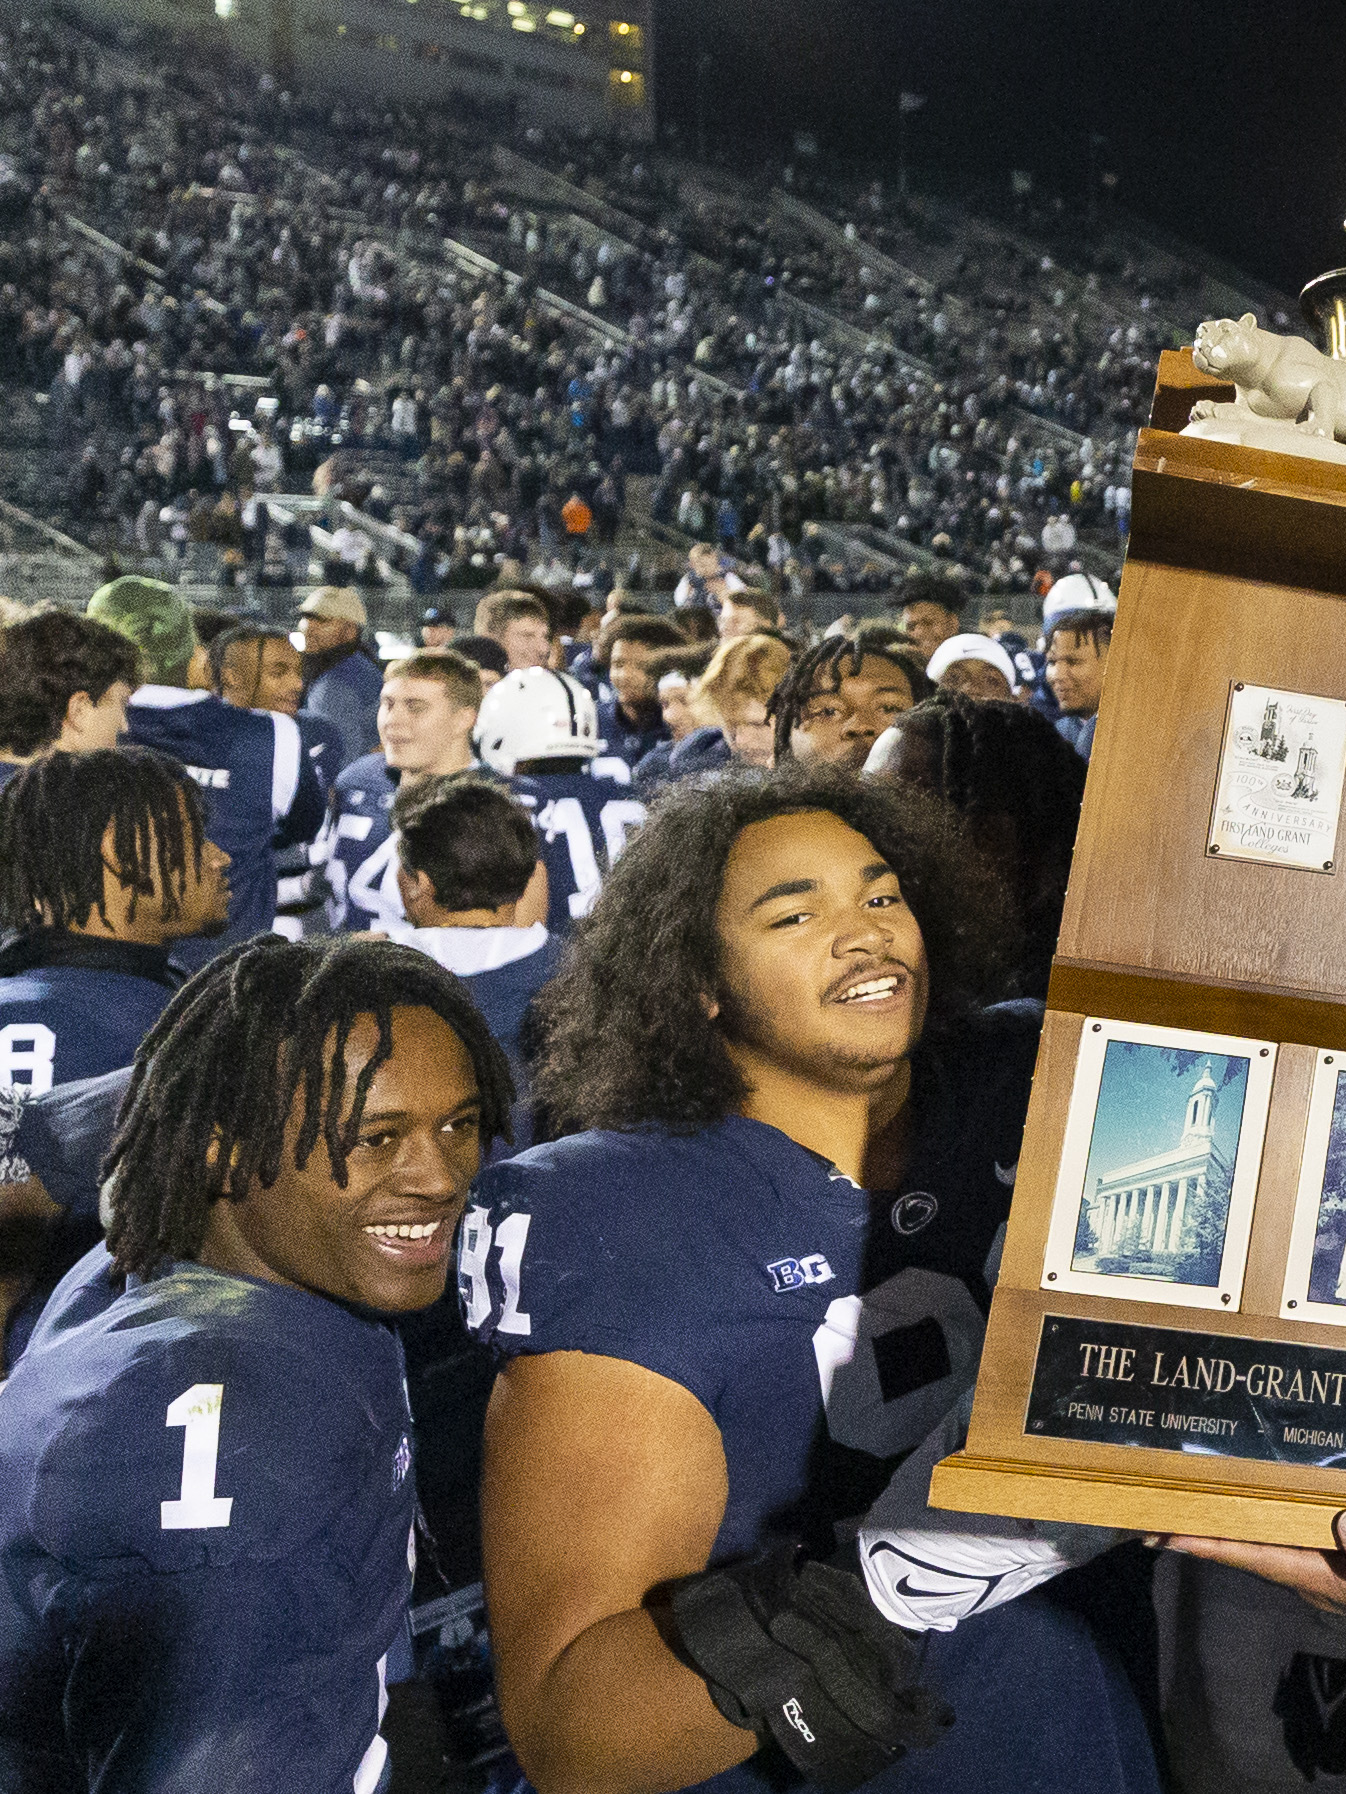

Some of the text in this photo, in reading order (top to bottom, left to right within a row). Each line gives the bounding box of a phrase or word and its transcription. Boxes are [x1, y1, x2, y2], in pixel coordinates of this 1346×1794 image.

[1220, 819, 1246, 836] FIRST
[1277, 828, 1312, 846] GRANT
[1243, 803, 1333, 833] ANNIVERSARY
[1240, 821, 1290, 855] Colleges
[1079, 1343, 1137, 1382] THE
[1067, 1401, 1104, 1422] PENN
[1108, 1406, 1156, 1428] STATE
[1160, 1412, 1239, 1437] UNIVERSITY
[1283, 1426, 1344, 1449] MICHIGAN
[160, 1383, 234, 1530] 1
